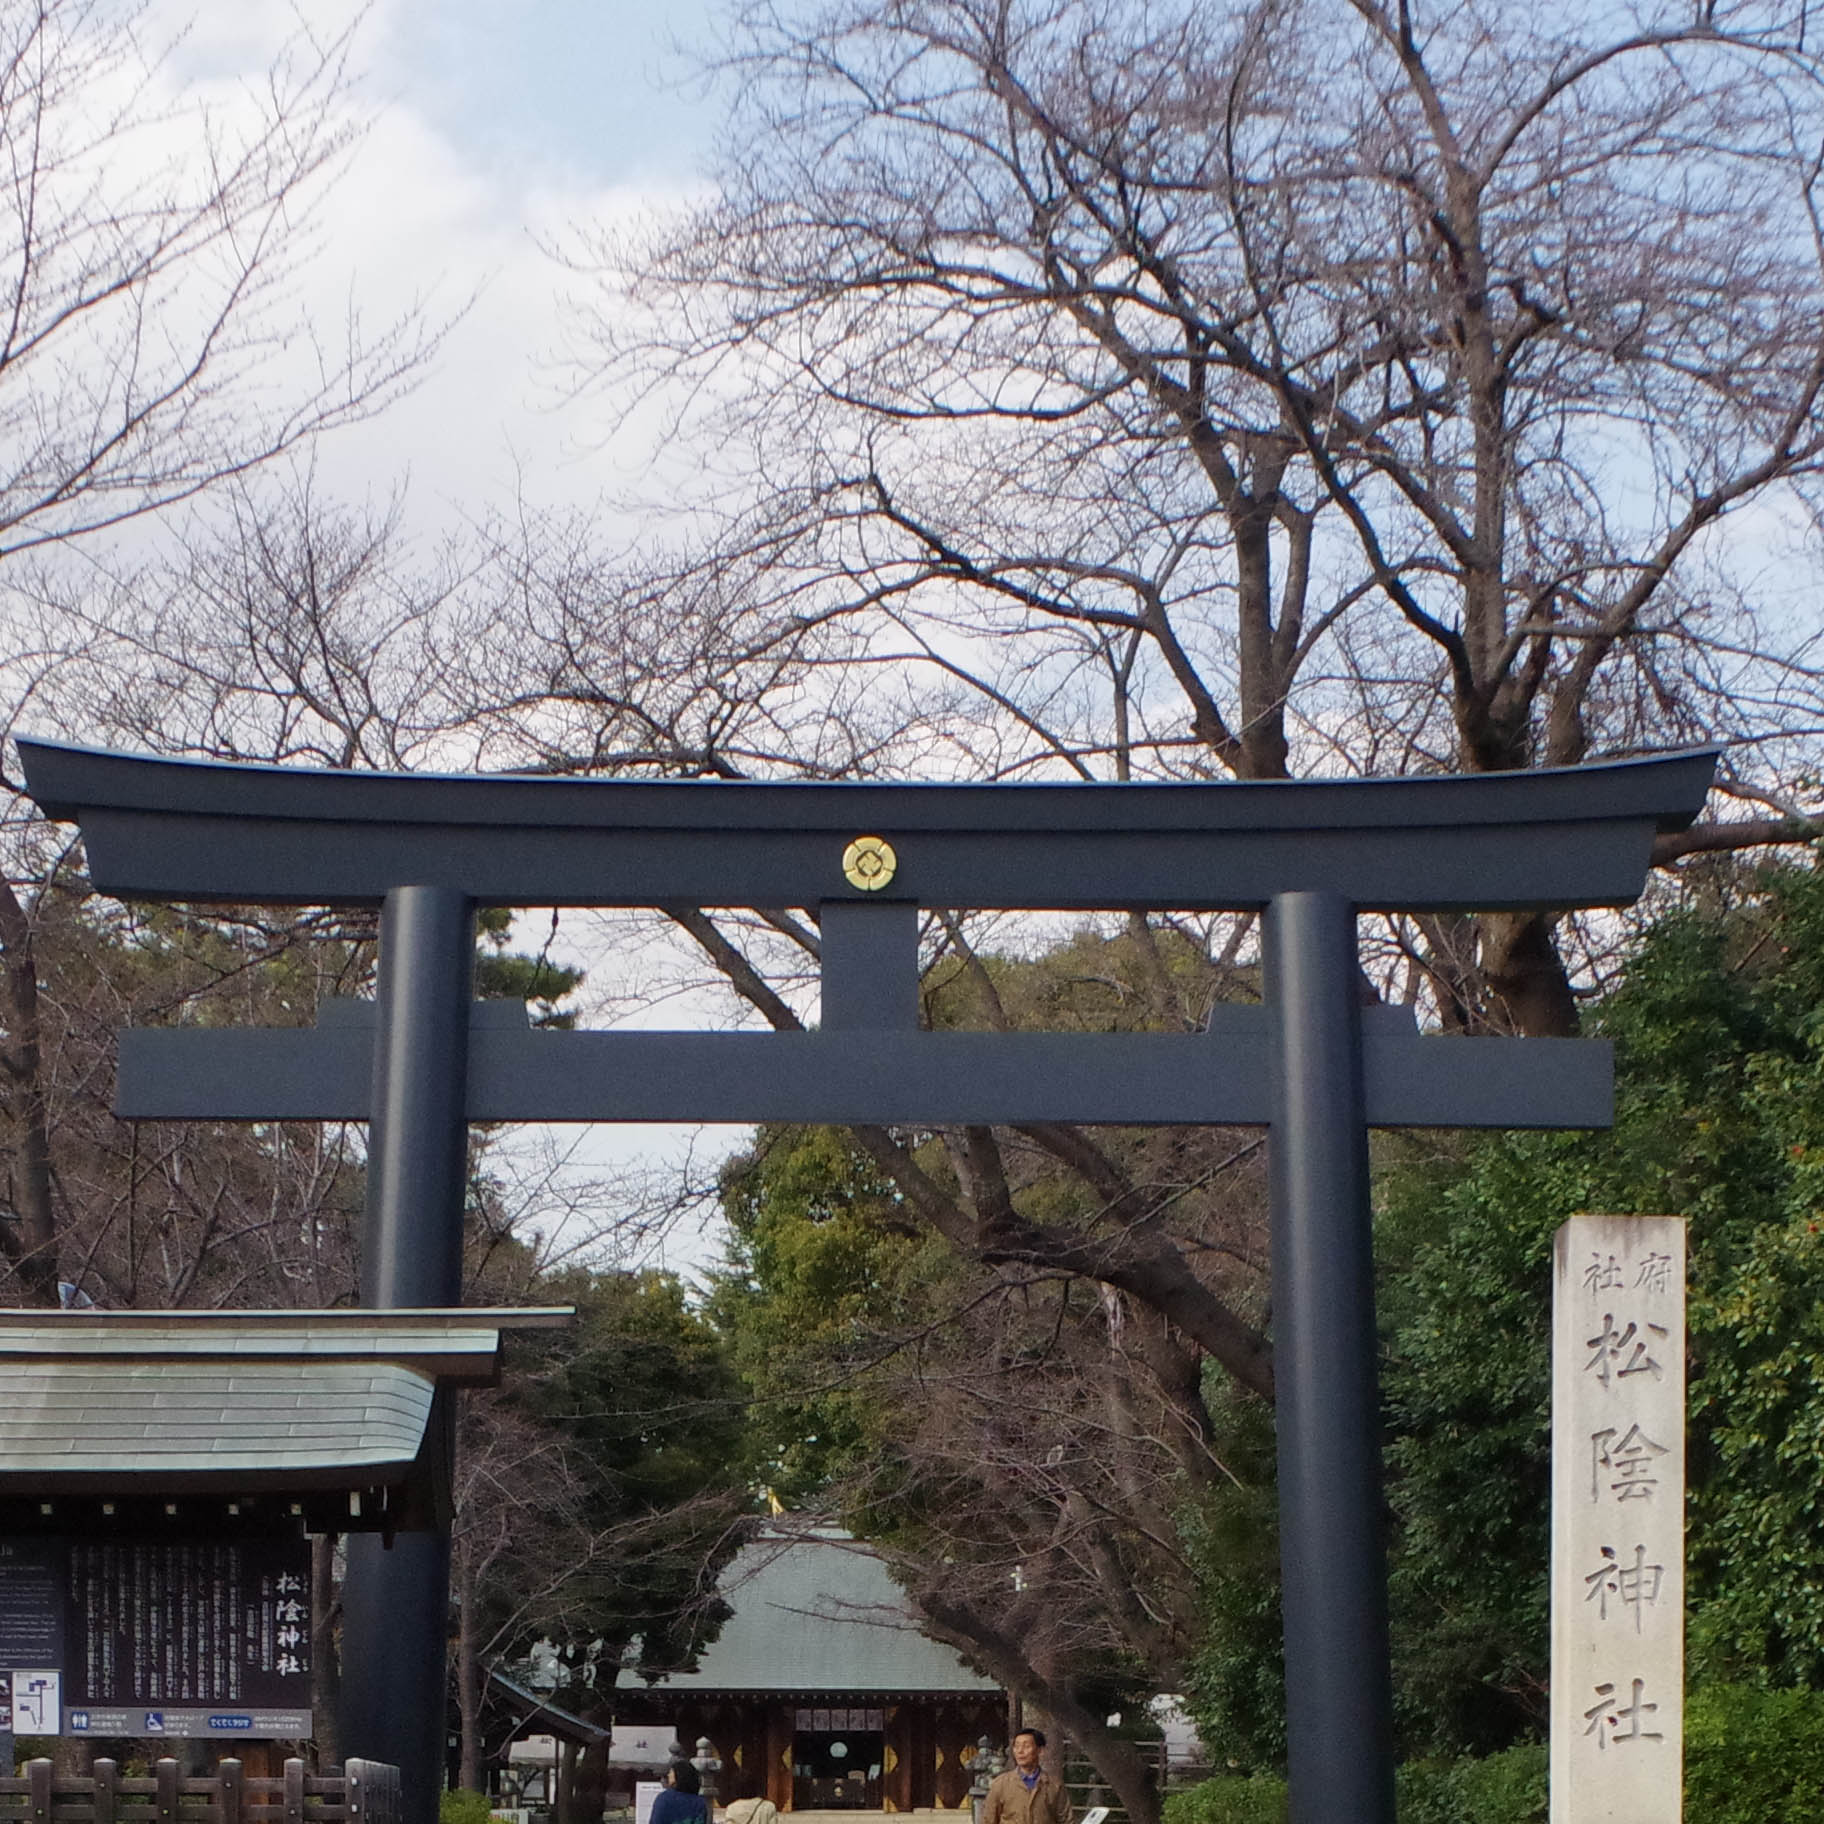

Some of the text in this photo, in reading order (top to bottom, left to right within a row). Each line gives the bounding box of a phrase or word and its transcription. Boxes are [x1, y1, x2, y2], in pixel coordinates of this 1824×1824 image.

[275, 1571, 302, 1677] 松陰神社
[1583, 1312, 1672, 1751] 松陰神社
